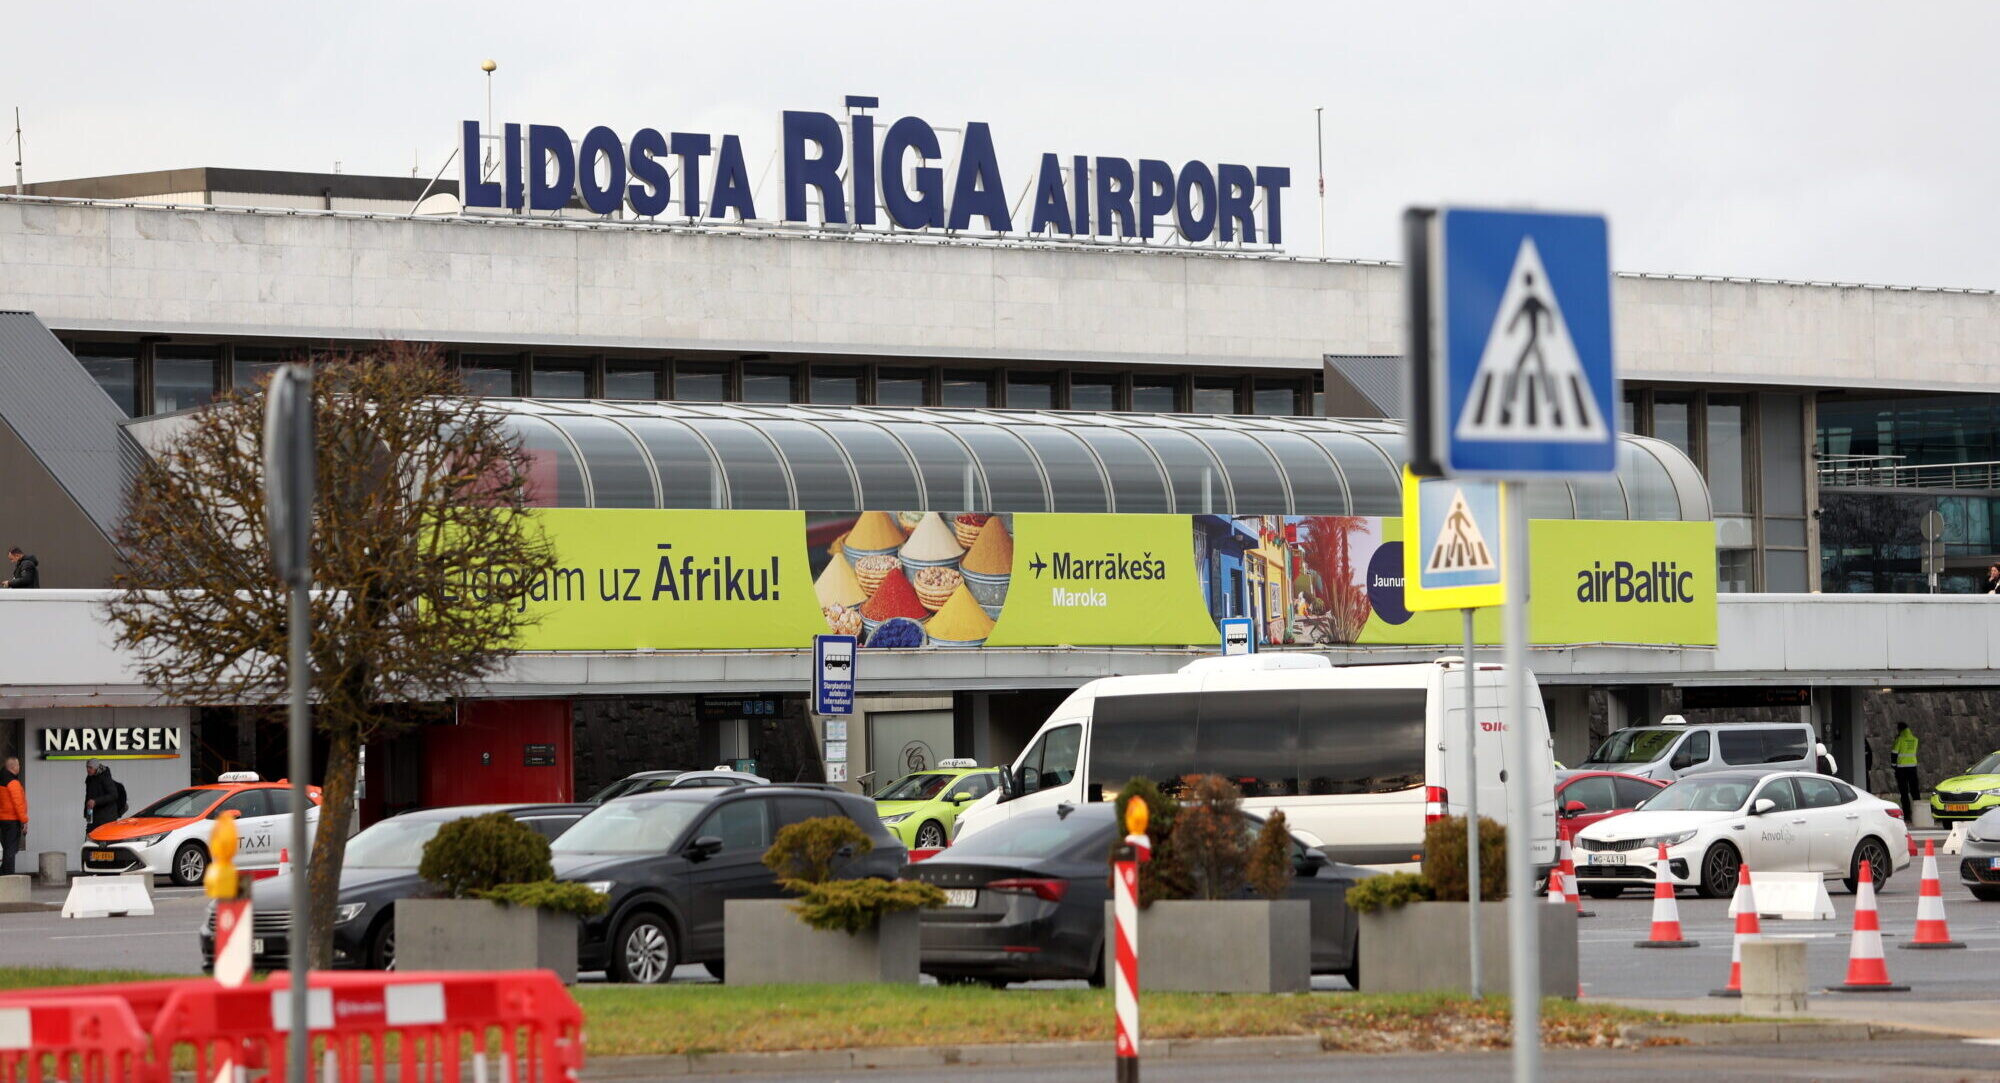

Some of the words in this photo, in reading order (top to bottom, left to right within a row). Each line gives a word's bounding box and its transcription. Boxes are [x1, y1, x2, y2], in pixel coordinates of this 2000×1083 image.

[462, 120, 756, 219] LIDOSTA
[782, 96, 1013, 231] RĪGA
[1031, 153, 1290, 244] AIRPORT
[599, 568, 642, 602] uz
[651, 543, 780, 602] Āfriku!
[1052, 551, 1166, 580] Marrākeša
[1577, 560, 1694, 604] airBaltic
[1053, 588, 1107, 606] Maroka
[45, 727, 181, 751] NARVESEN
[237, 834, 271, 849] TAXI
